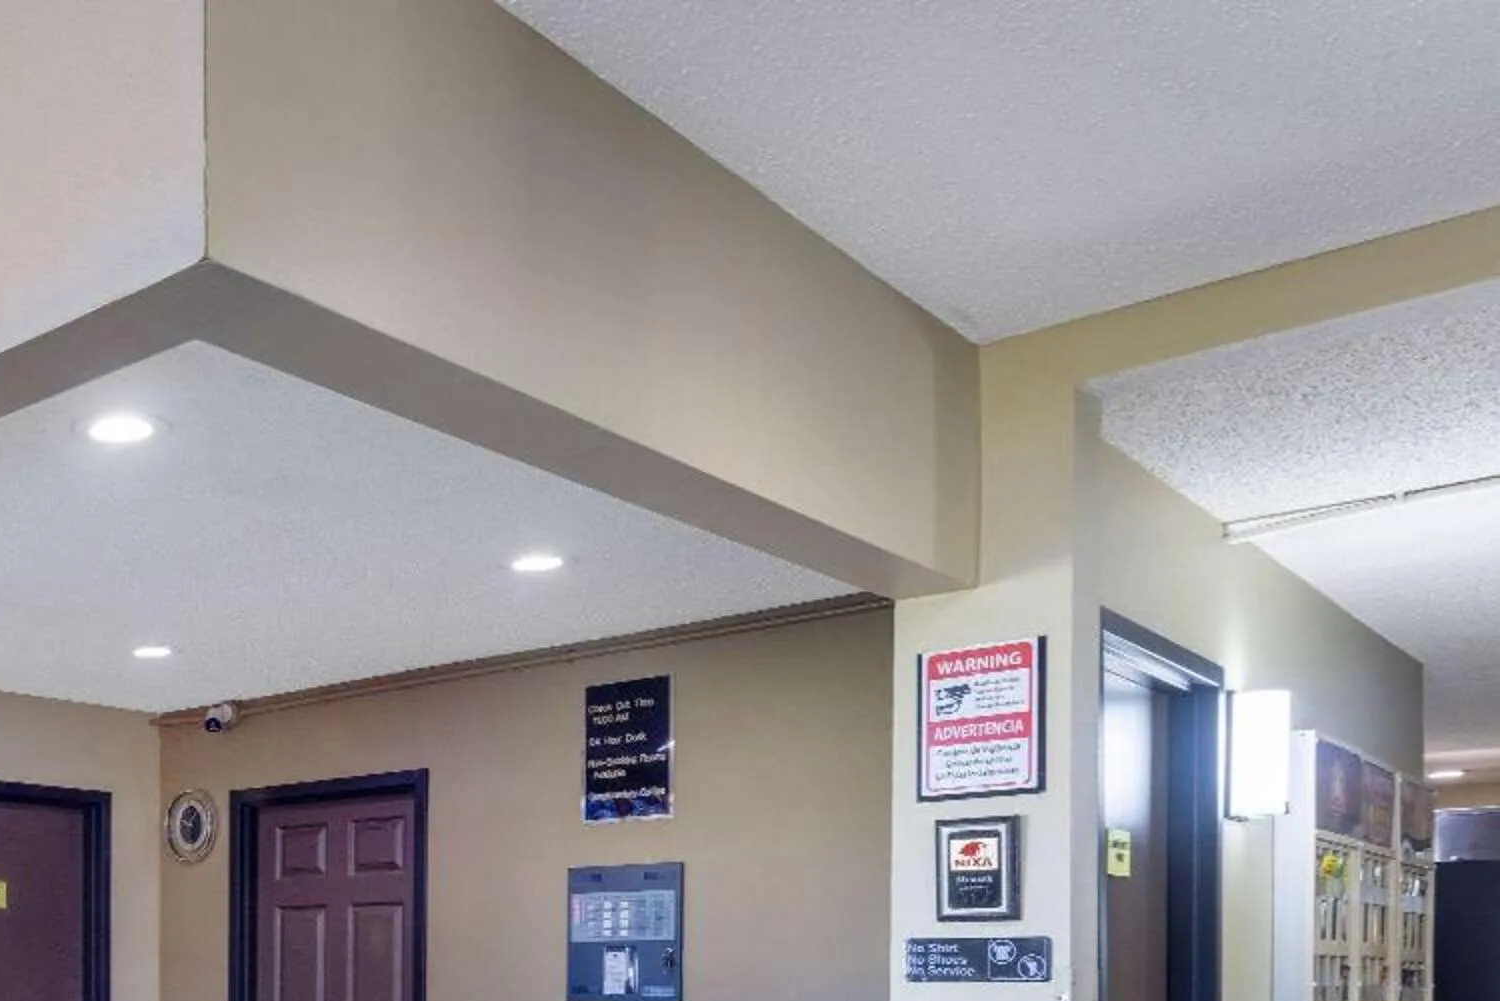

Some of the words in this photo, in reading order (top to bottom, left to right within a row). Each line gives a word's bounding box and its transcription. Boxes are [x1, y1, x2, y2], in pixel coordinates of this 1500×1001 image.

[936, 651, 1022, 675] WARNING
[933, 719, 1024, 741] ADVERTENCIA
[954, 856, 993, 867] NIXA
[907, 943, 925, 953] No
[928, 943, 959, 953] Shirt
[907, 955, 925, 965] No
[928, 954, 967, 965] Shoes
[907, 966, 925, 977] No
[927, 966, 975, 977] Service
